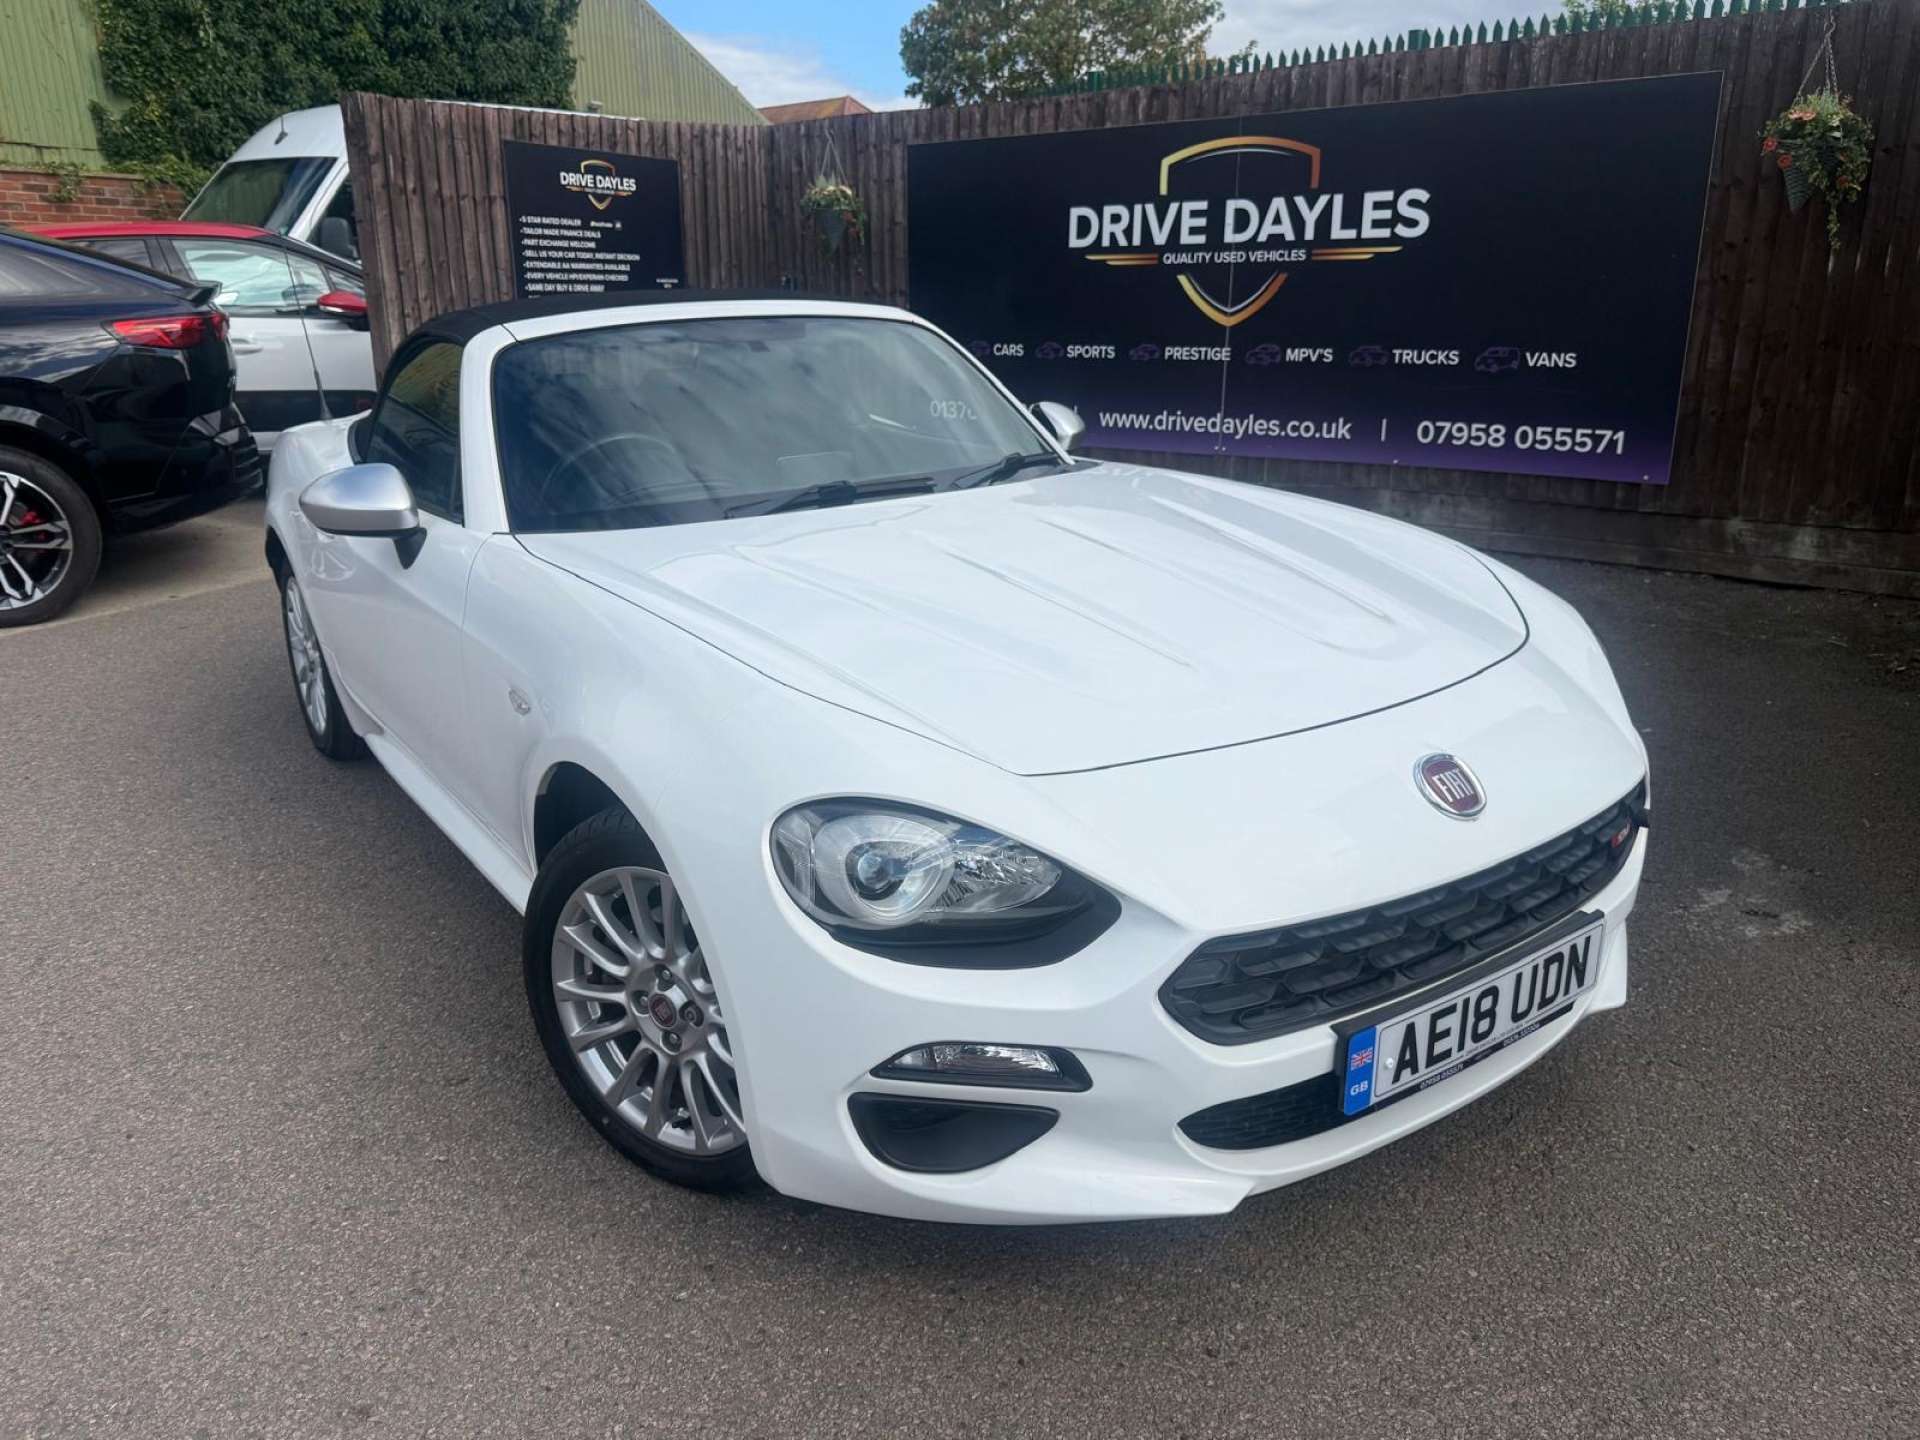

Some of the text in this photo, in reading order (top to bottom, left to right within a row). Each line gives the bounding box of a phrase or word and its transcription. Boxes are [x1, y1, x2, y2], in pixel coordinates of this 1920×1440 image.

[560, 171, 595, 188] DRIVE
[595, 175, 637, 191] DAYLES
[1068, 188, 1431, 248] DRIVE DAYLES
[539, 239, 569, 247] EXCHANGE
[1163, 249, 1306, 264] QUALITY USED VEHICLES
[993, 343, 1577, 367] CARS SPORTS PRESTIGE MPV'S TRUCKS VANS
[1099, 410, 1352, 440] www.drivedayles.co.uk
[1417, 421, 1507, 447] 07958
[1514, 425, 1626, 455] 055571
[1431, 768, 1475, 803] FIAT
[1391, 985, 1500, 1085] AE18
[1511, 936, 1591, 1024] UDN
[1350, 1080, 1369, 1096] GB
